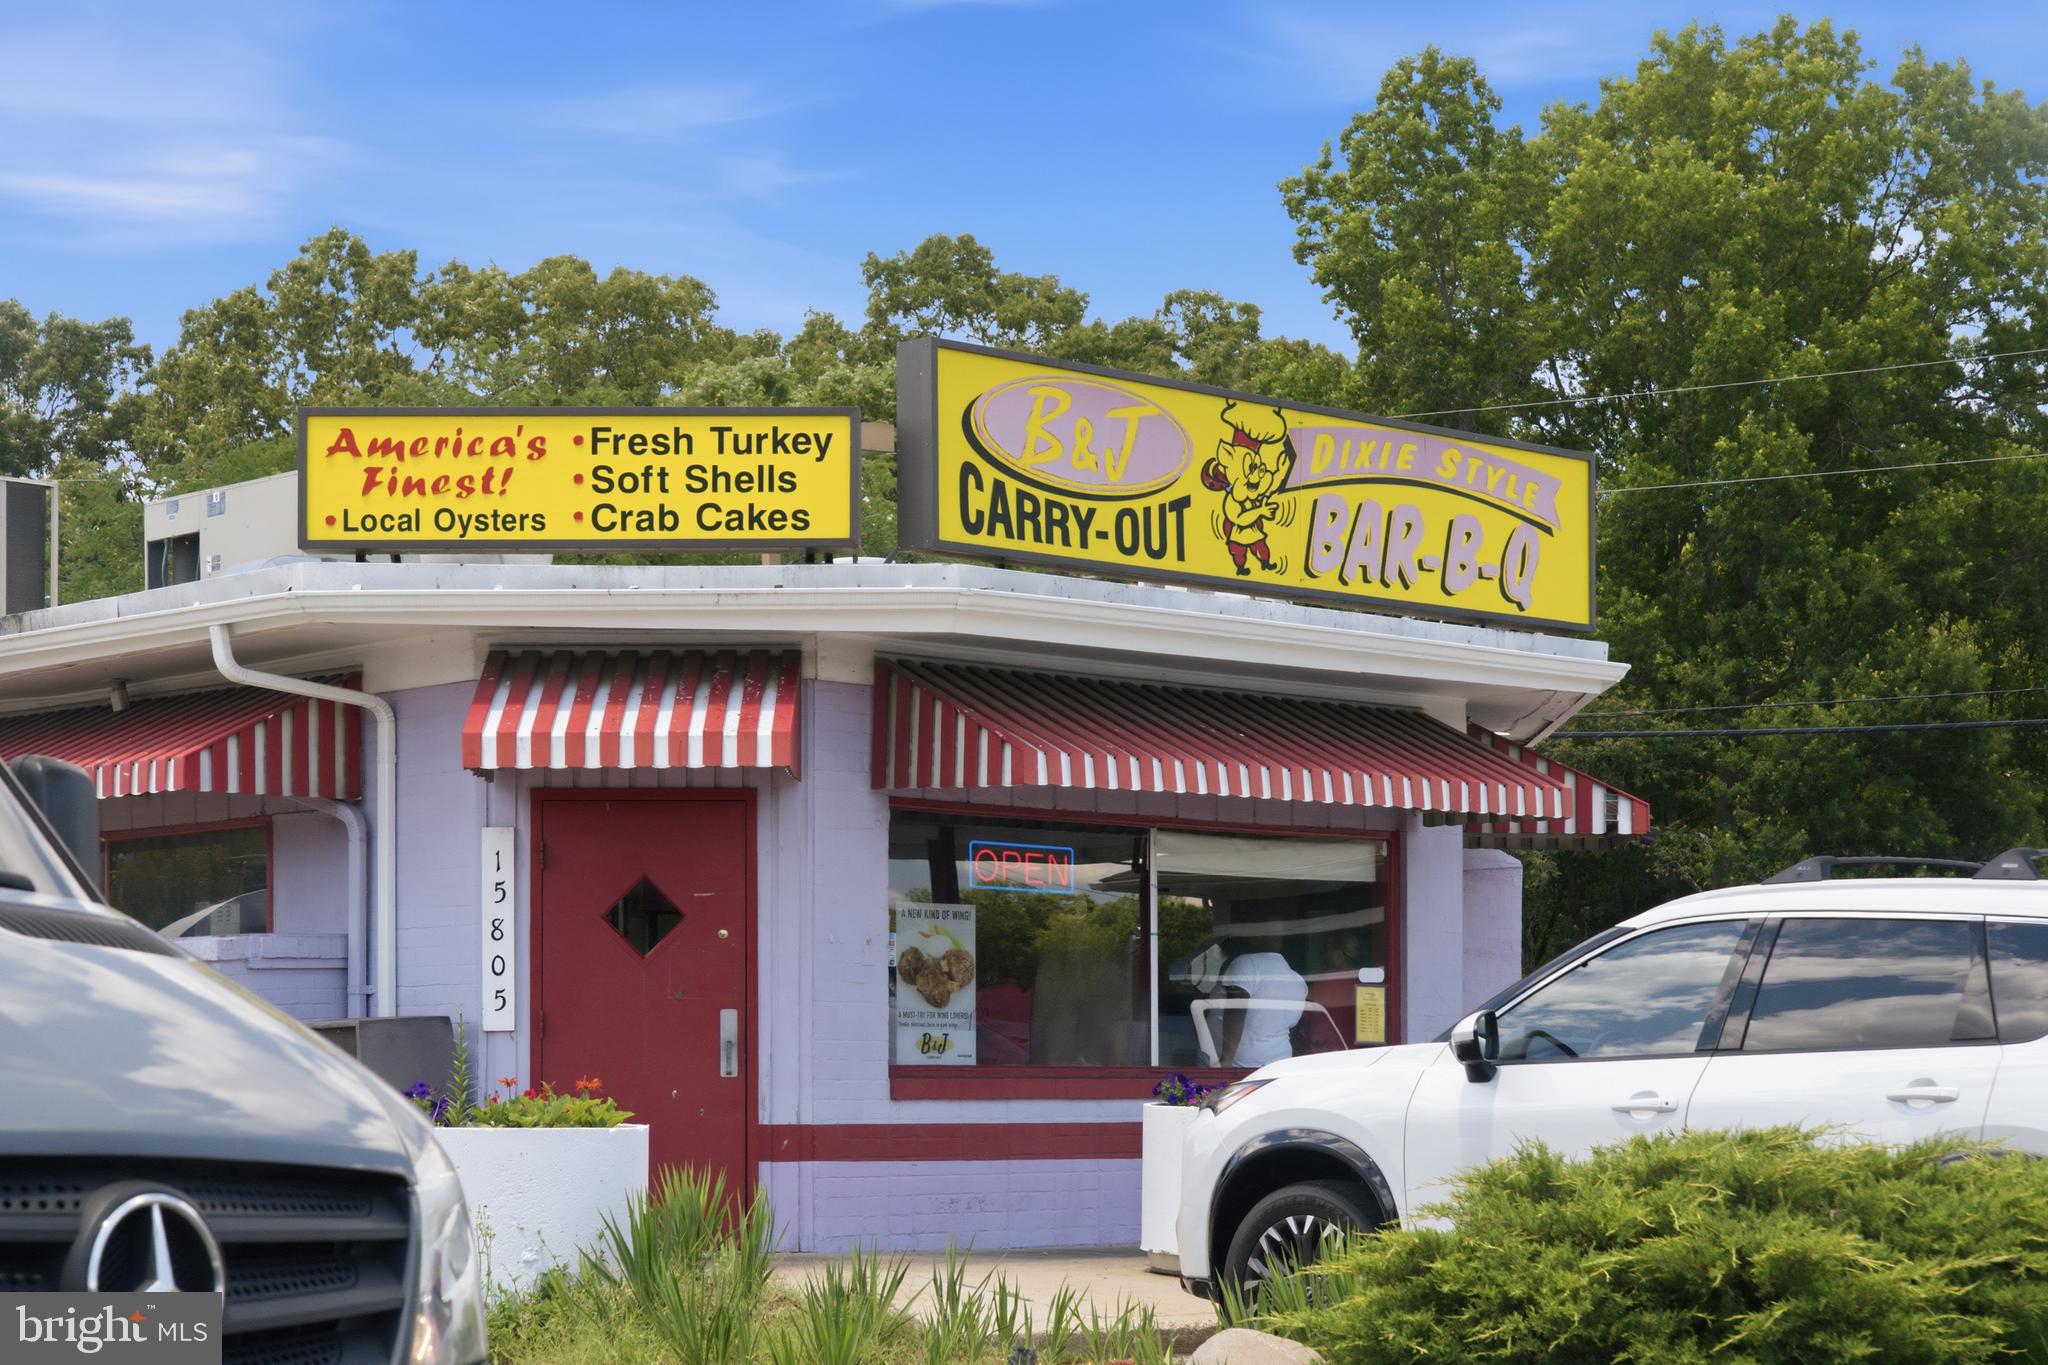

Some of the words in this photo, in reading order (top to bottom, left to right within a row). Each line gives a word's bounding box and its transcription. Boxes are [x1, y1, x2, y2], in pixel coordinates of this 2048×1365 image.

[325, 424, 547, 463] America's
[591, 426, 694, 455] Fresh
[709, 425, 833, 463] Turkey
[1017, 385, 1161, 483] B&J
[361, 465, 514, 499] Finest!
[591, 464, 670, 494] Soft
[685, 464, 798, 493] Shells
[1310, 432, 1419, 475] DIXIE
[1434, 447, 1541, 509] STYLE
[343, 507, 421, 532] Local
[434, 507, 547, 539] Oysters
[591, 502, 680, 532] Crab
[696, 502, 811, 531] Cakes
[959, 460, 1192, 562] CARRY-OUT
[1304, 493, 1540, 612] BAR-B-Q
[975, 848, 1069, 887] OPEN
[490, 849, 507, 1012] 15805
[907, 908, 922, 919] NEW
[924, 909, 940, 920] KIND
[941, 910, 950, 921] OF
[952, 910, 972, 921] WING!
